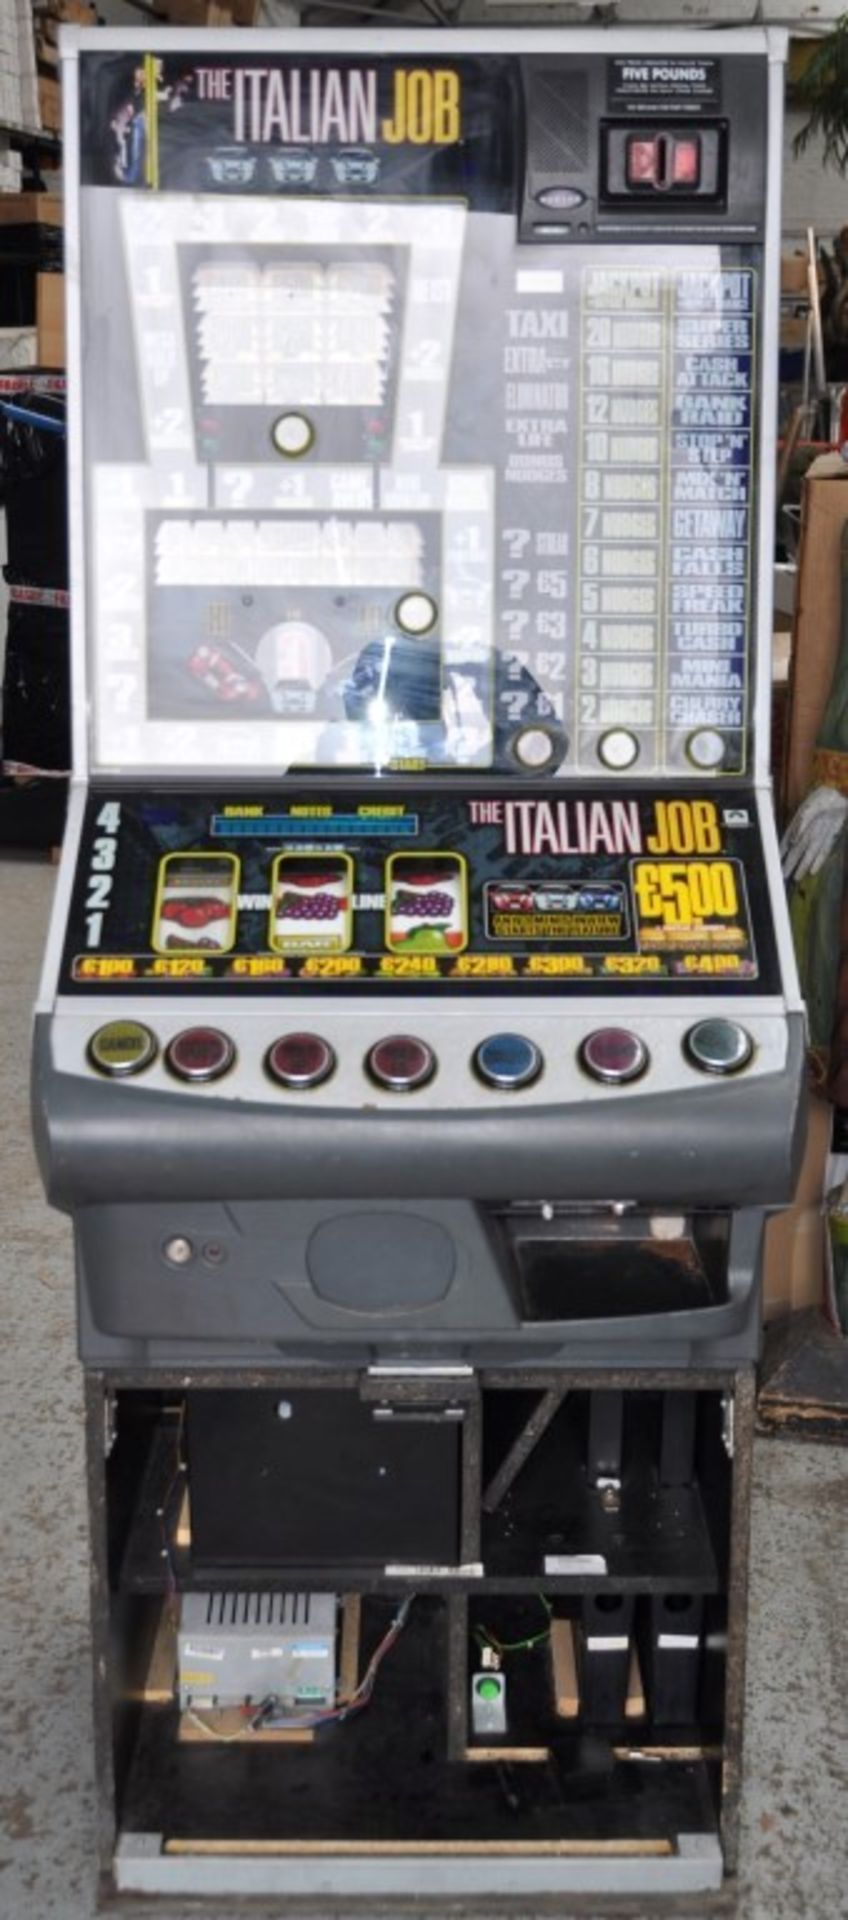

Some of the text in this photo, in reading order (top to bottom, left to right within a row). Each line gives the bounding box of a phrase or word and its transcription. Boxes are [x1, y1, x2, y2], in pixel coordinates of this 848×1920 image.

[622, 67, 706, 81] FIVE POUNDS
[195, 69, 460, 146] THE ITALIAN JOB
[505, 309, 568, 339] TAXI
[504, 346, 546, 374] EXTRA
[684, 357, 738, 372] CASH
[677, 372, 748, 388] ATTACK
[676, 394, 748, 411] BANK
[505, 418, 568, 433] EXTRA
[680, 411, 744, 426] RAID
[517, 433, 554, 448] LIFE
[675, 433, 722, 449] STOP
[672, 487, 747, 502] MATCH
[583, 507, 601, 539] 7
[502, 528, 531, 559] ?
[672, 547, 744, 562] CASH
[672, 562, 744, 577] FALLS
[502, 569, 530, 600] ?
[583, 582, 599, 613] 5
[502, 610, 530, 641] ?
[582, 620, 598, 651] 4
[677, 637, 738, 652] CASH
[582, 657, 598, 688] 3
[681, 659, 732, 674] MINI
[672, 674, 743, 689] MANIA
[500, 691, 530, 722] ?
[580, 694, 597, 724] 2
[96, 801, 121, 834] 4
[224, 805, 264, 818] BANK
[469, 801, 722, 856] THE ITALIAN JOB
[92, 837, 117, 870] 3
[86, 874, 113, 909] 2
[237, 893, 387, 911] WIN LINE
[636, 862, 738, 926] £500
[86, 912, 104, 948] 1
